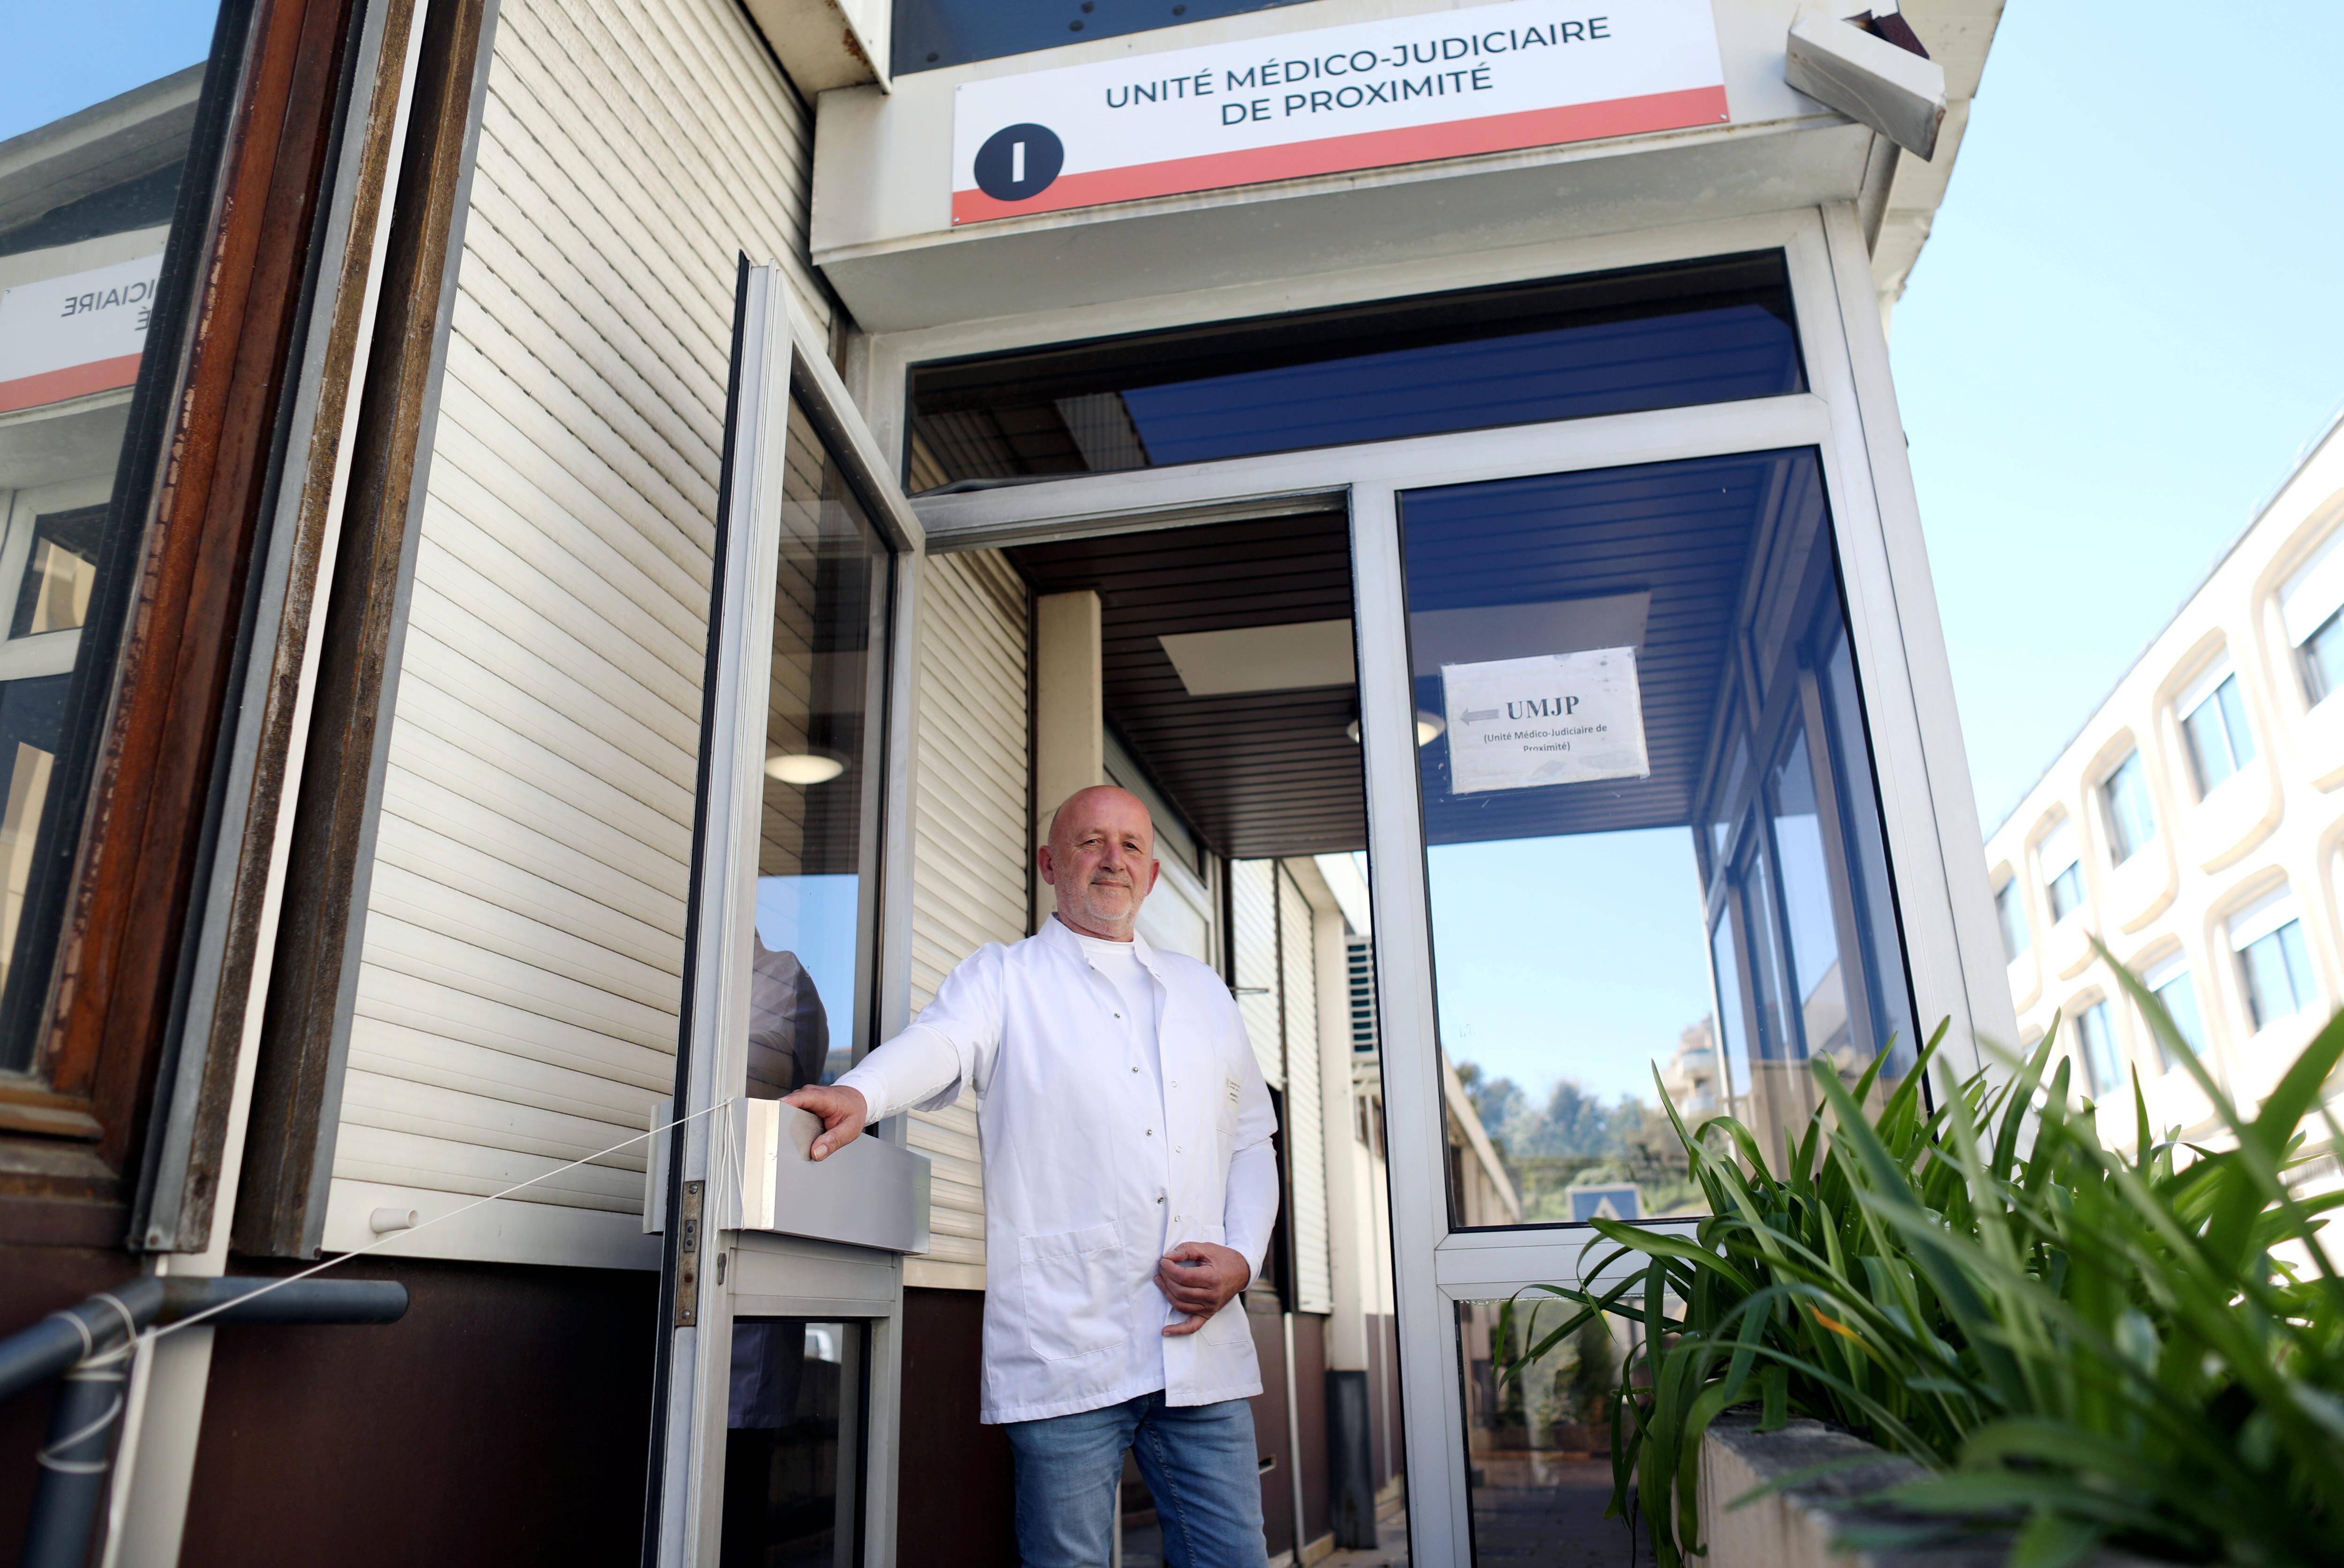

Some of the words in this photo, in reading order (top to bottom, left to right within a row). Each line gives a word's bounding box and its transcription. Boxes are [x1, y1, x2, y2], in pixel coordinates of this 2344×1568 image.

[1106, 68, 1214, 109] UNITÉ
[1226, 16, 1611, 91] MÉDICO-JUDICIAIRE
[1222, 98, 1272, 126] DE
[1285, 64, 1494, 117] PROXIMITÉ
[1506, 696, 1580, 720] UMJP
[1484, 732, 1512, 744] (Unité
[1514, 726, 1593, 740] Médico-Judiciaire
[1523, 741, 1571, 752] Proximité)
